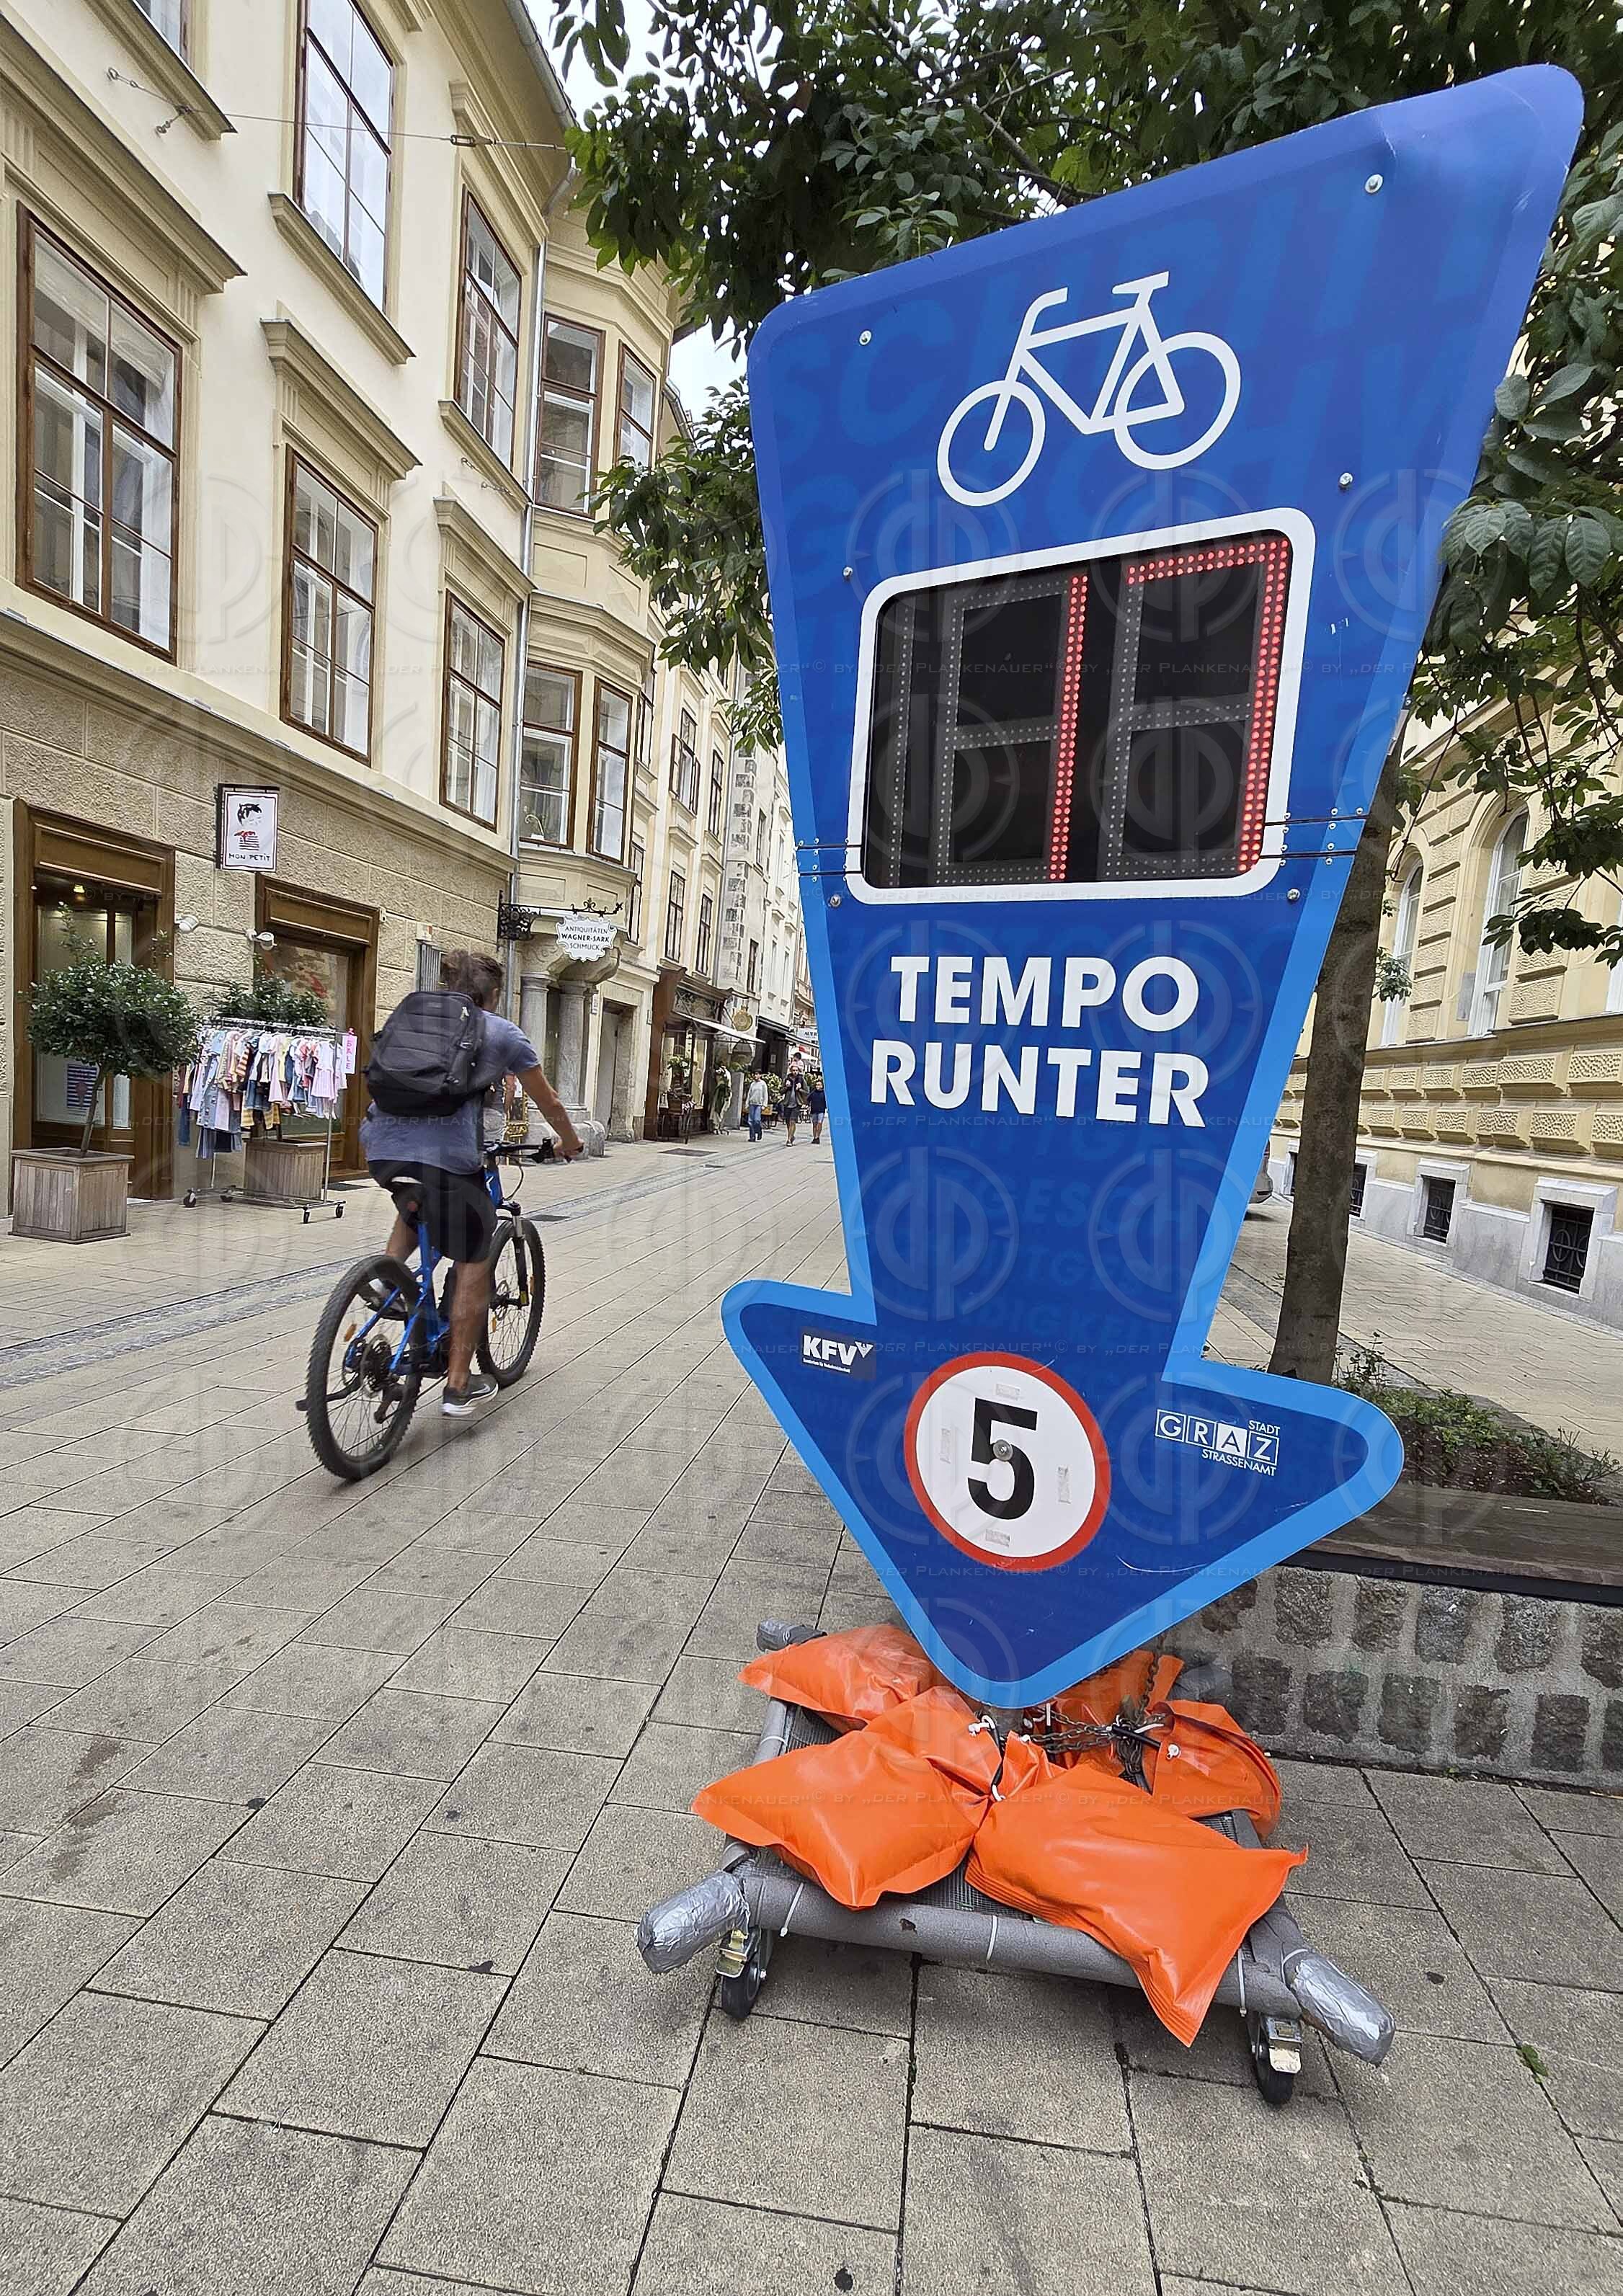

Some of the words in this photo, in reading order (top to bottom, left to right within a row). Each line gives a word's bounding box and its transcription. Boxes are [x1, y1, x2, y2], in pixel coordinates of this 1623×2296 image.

[561, 933, 610, 943] WAGNER-SARK
[890, 956, 1200, 1031] TEMPO
[870, 1039, 1209, 1129] RUNTER
[803, 1334, 858, 1366] KFV
[1159, 1414, 1273, 1461] GRAZ
[1248, 1420, 1281, 1436] STADT
[966, 1398, 1039, 1521] 5
[1201, 1449, 1277, 1477] STRASSENAMT
